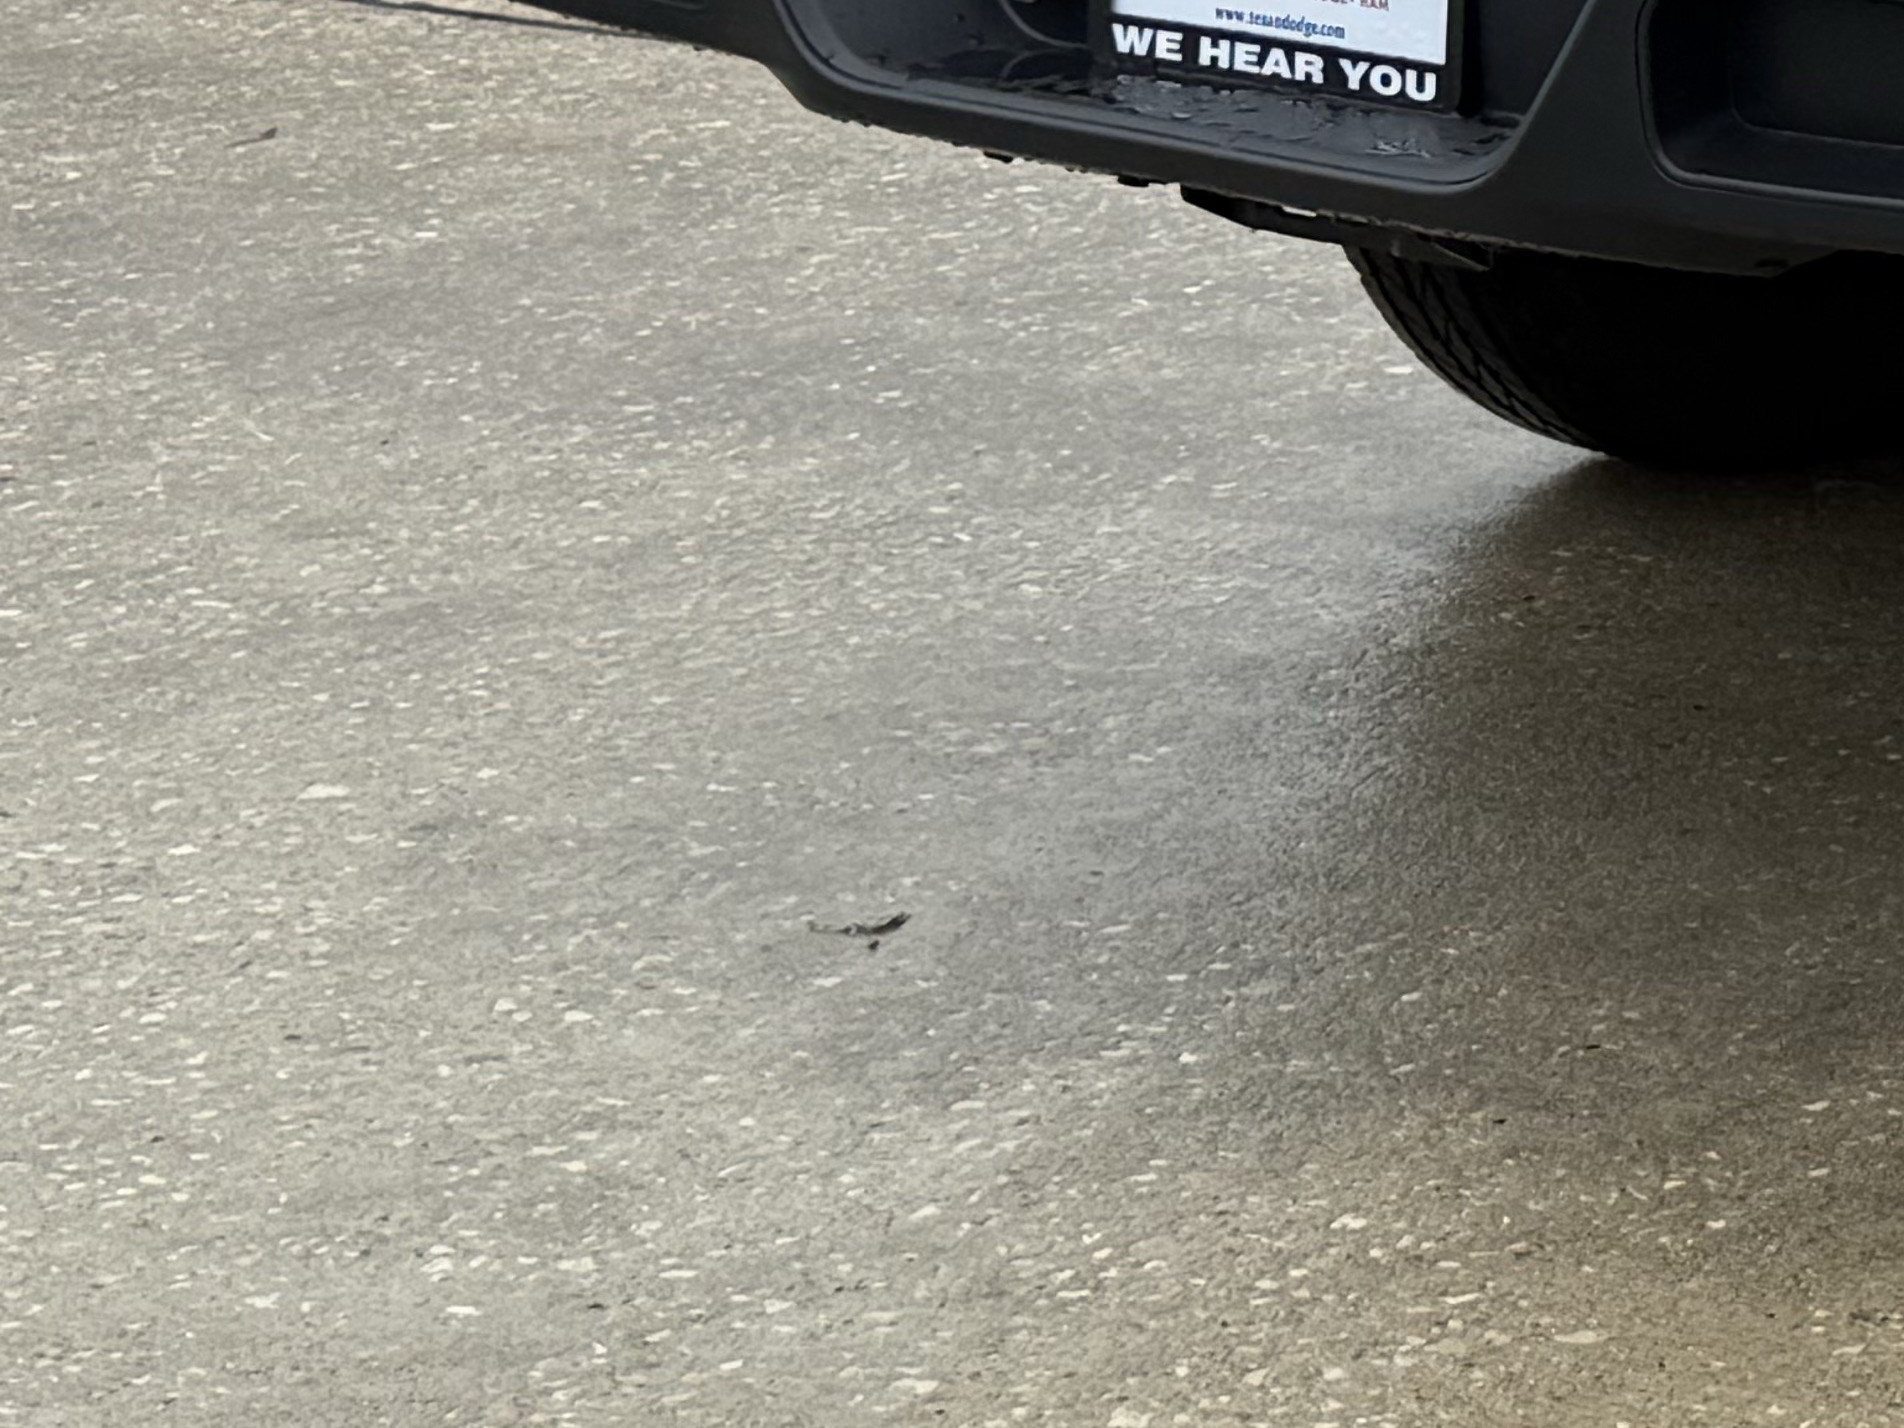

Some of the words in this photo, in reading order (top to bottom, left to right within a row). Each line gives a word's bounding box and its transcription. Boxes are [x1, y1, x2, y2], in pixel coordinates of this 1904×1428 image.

[1111, 23, 1183, 62] WE
[1198, 35, 1325, 85] HEAR
[1338, 57, 1438, 102] YOU
